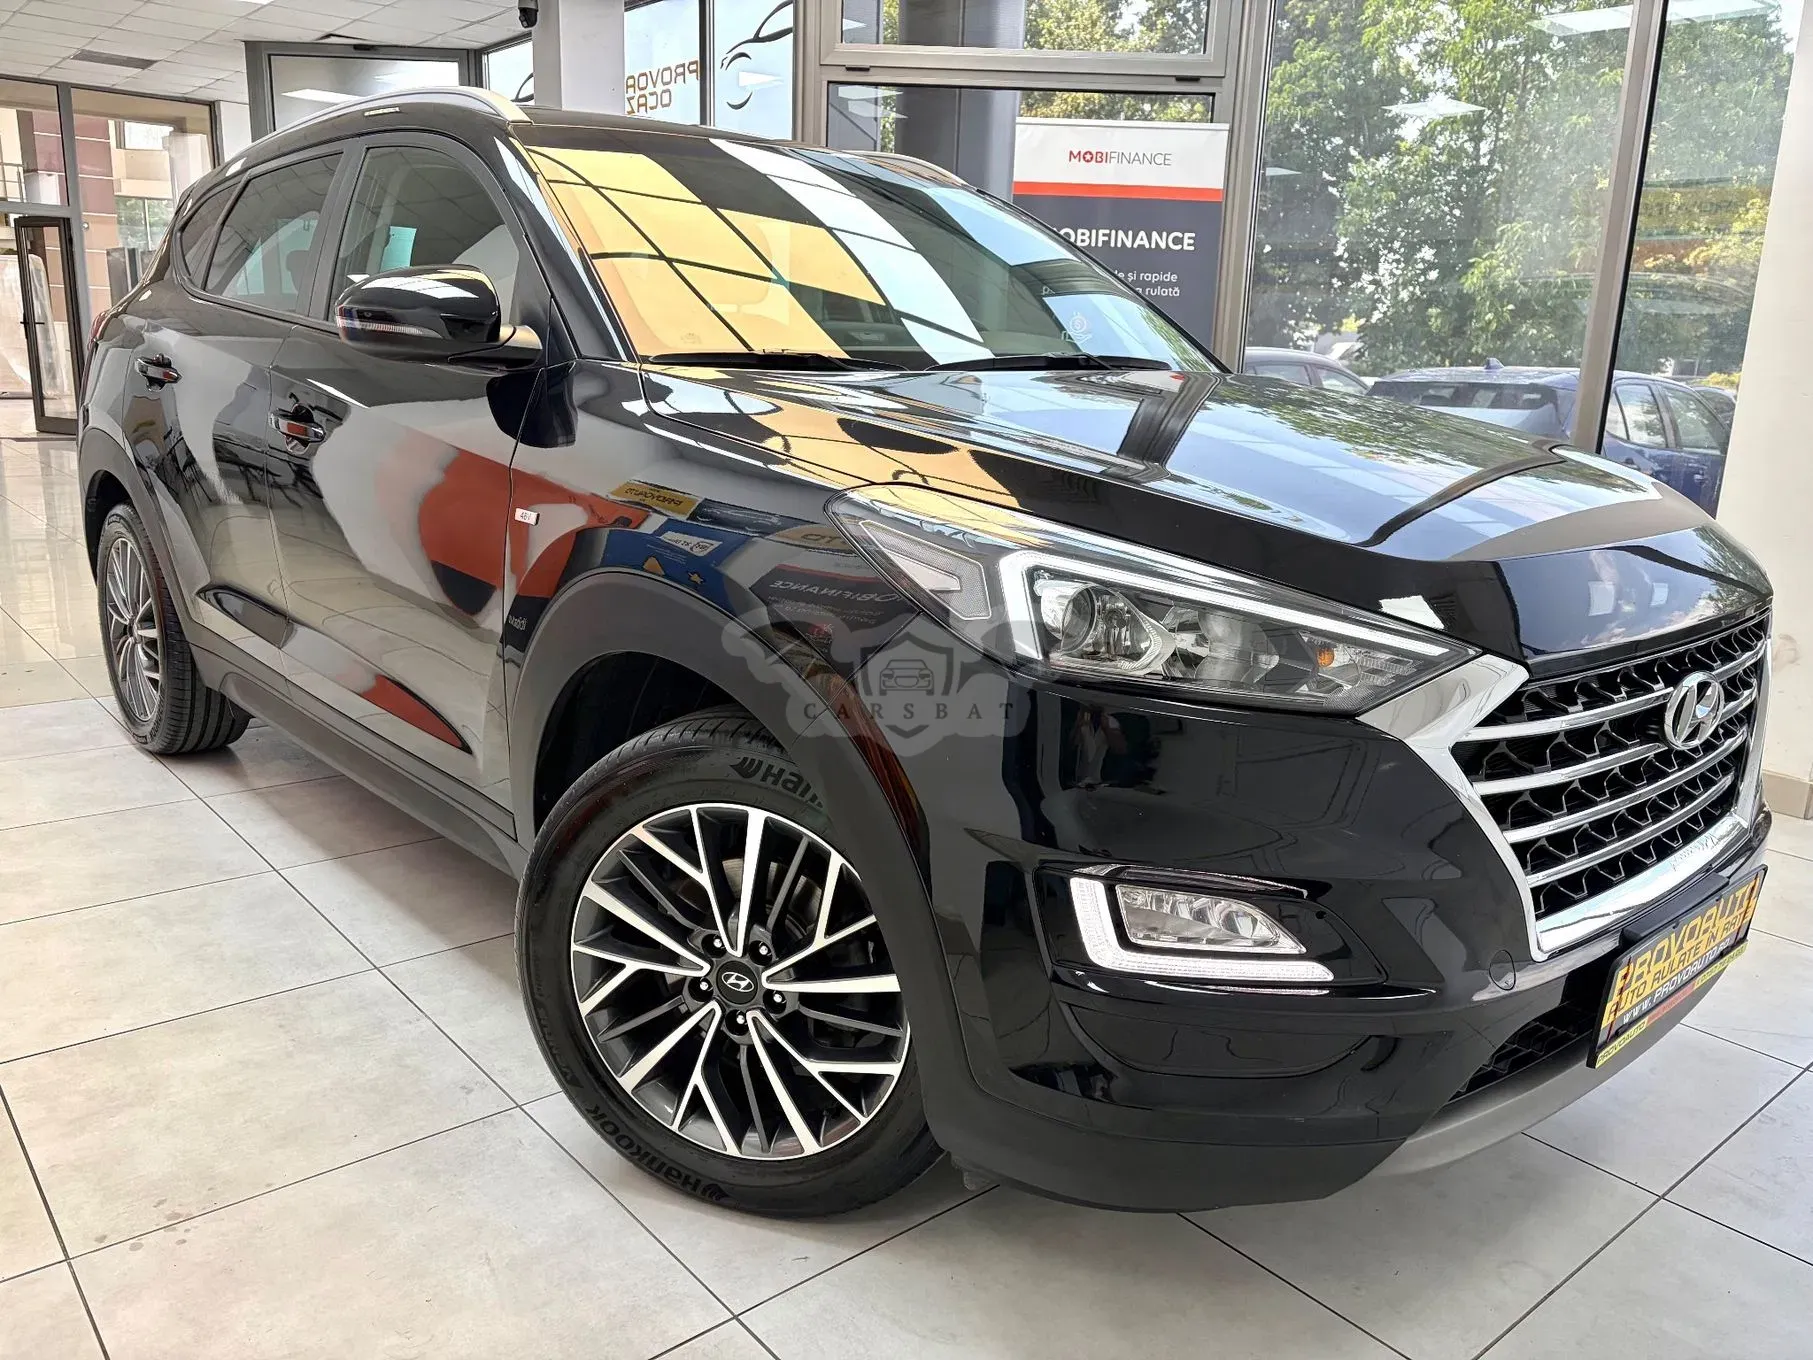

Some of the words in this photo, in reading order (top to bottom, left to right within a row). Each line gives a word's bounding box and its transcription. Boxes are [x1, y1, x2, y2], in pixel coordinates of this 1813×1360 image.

[1068, 150, 1172, 166] MOBIFINANCE
[1053, 227, 1196, 251] OBIFINANCE
[1140, 271, 1178, 284] rapide
[1652, 945, 1700, 987] RULATE
